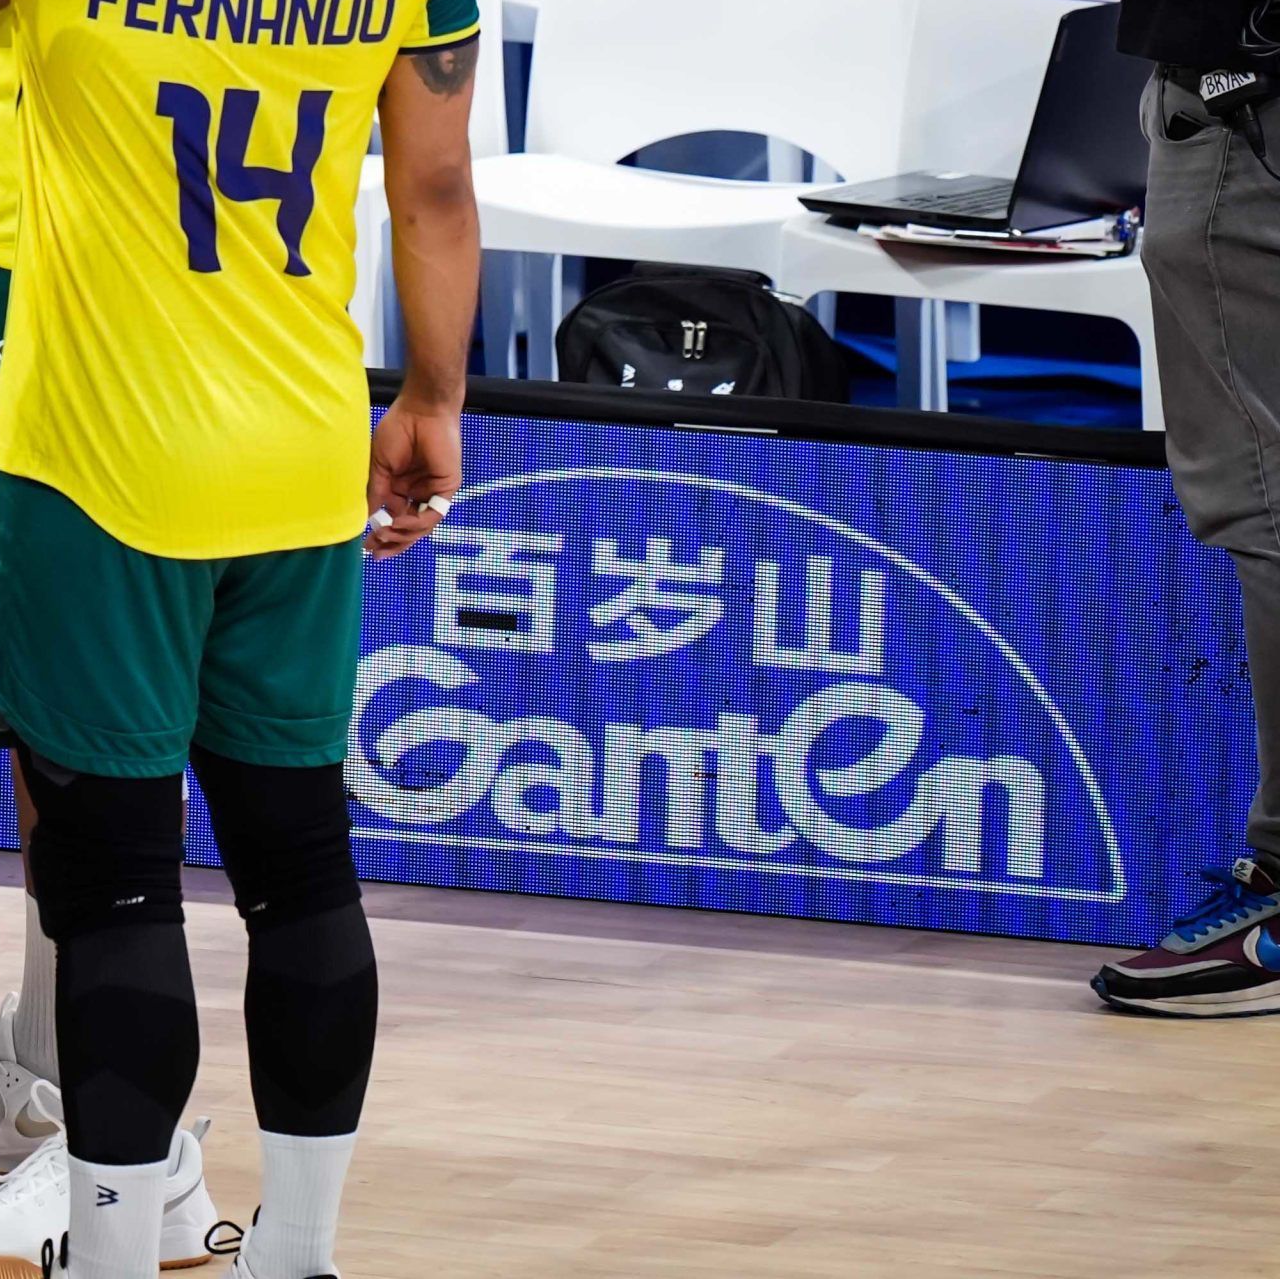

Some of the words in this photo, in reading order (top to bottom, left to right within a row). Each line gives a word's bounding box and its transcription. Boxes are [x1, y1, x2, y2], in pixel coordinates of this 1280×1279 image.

[156, 80, 334, 277] 14
[430, 524, 885, 678] 百岁山
